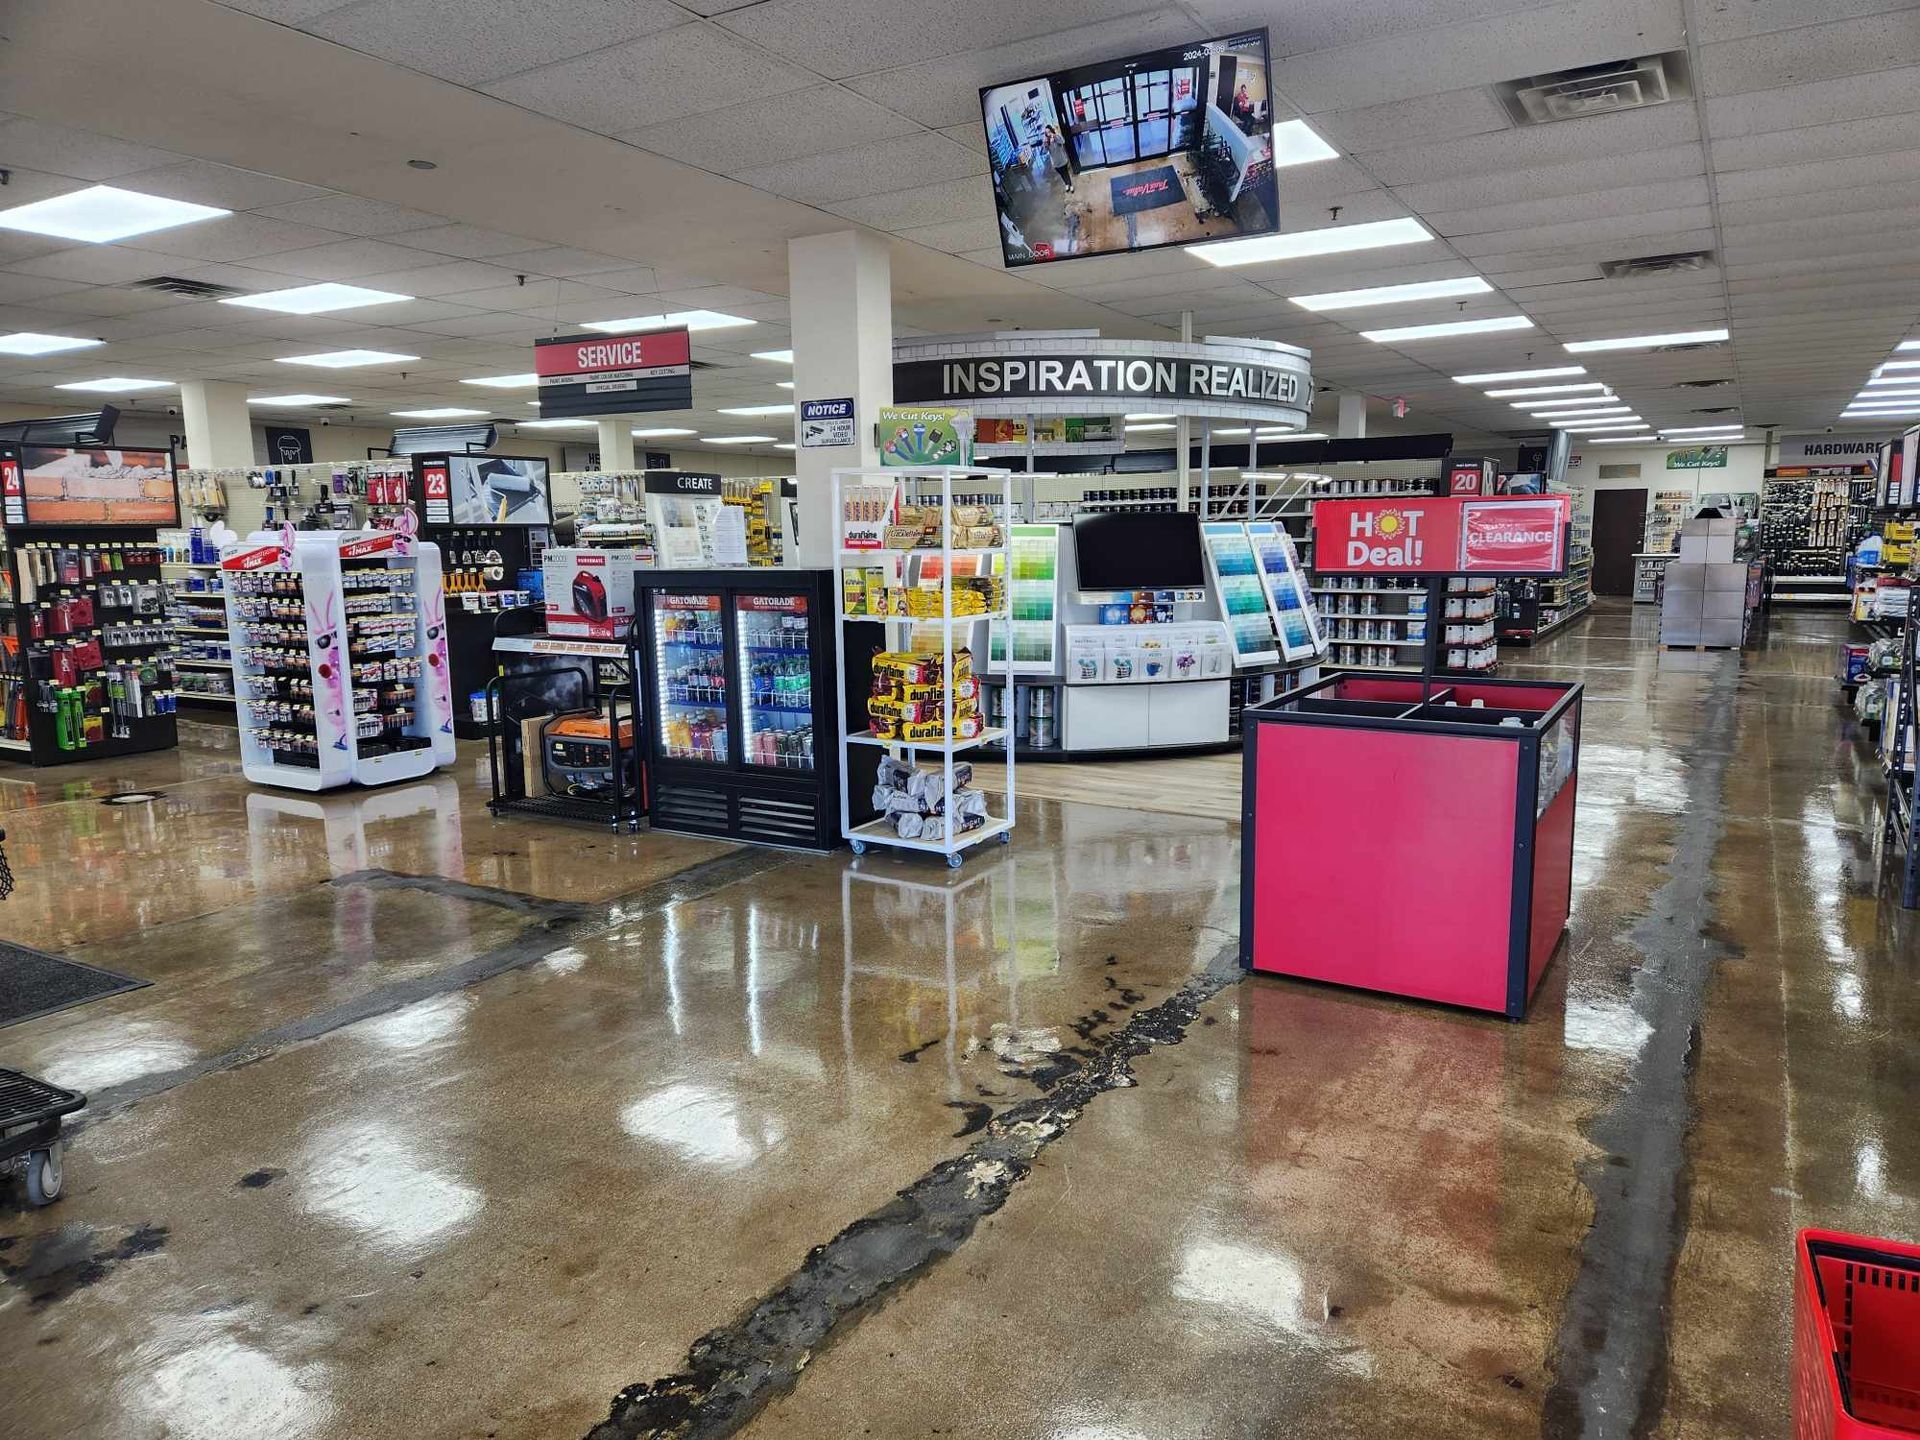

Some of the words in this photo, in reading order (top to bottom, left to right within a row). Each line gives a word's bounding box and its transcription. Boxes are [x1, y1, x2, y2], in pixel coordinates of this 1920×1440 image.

[577, 341, 642, 368] SERVICE
[943, 360, 1177, 395] INSPIRATION
[1189, 364, 1298, 401] REALIZED
[808, 403, 847, 416] NOTICE
[882, 411, 897, 420] We
[901, 411, 917, 420] Cut
[921, 411, 945, 422] Keys!
[4, 466, 20, 490] 24
[427, 473, 445, 494] 23
[677, 477, 713, 490] CREATE
[1455, 473, 1477, 490] 20
[1350, 508, 1424, 540] HOT
[1469, 530, 1553, 544] CLEARANCE
[1346, 540, 1423, 567] Deal!
[669, 596, 709, 605] GATORADE
[753, 597, 795, 606] GATORADE
[873, 664, 905, 678] duraflame
[910, 686, 956, 700] duraflae
[870, 703, 901, 716] duraflame
[910, 725, 957, 738] duraflae
